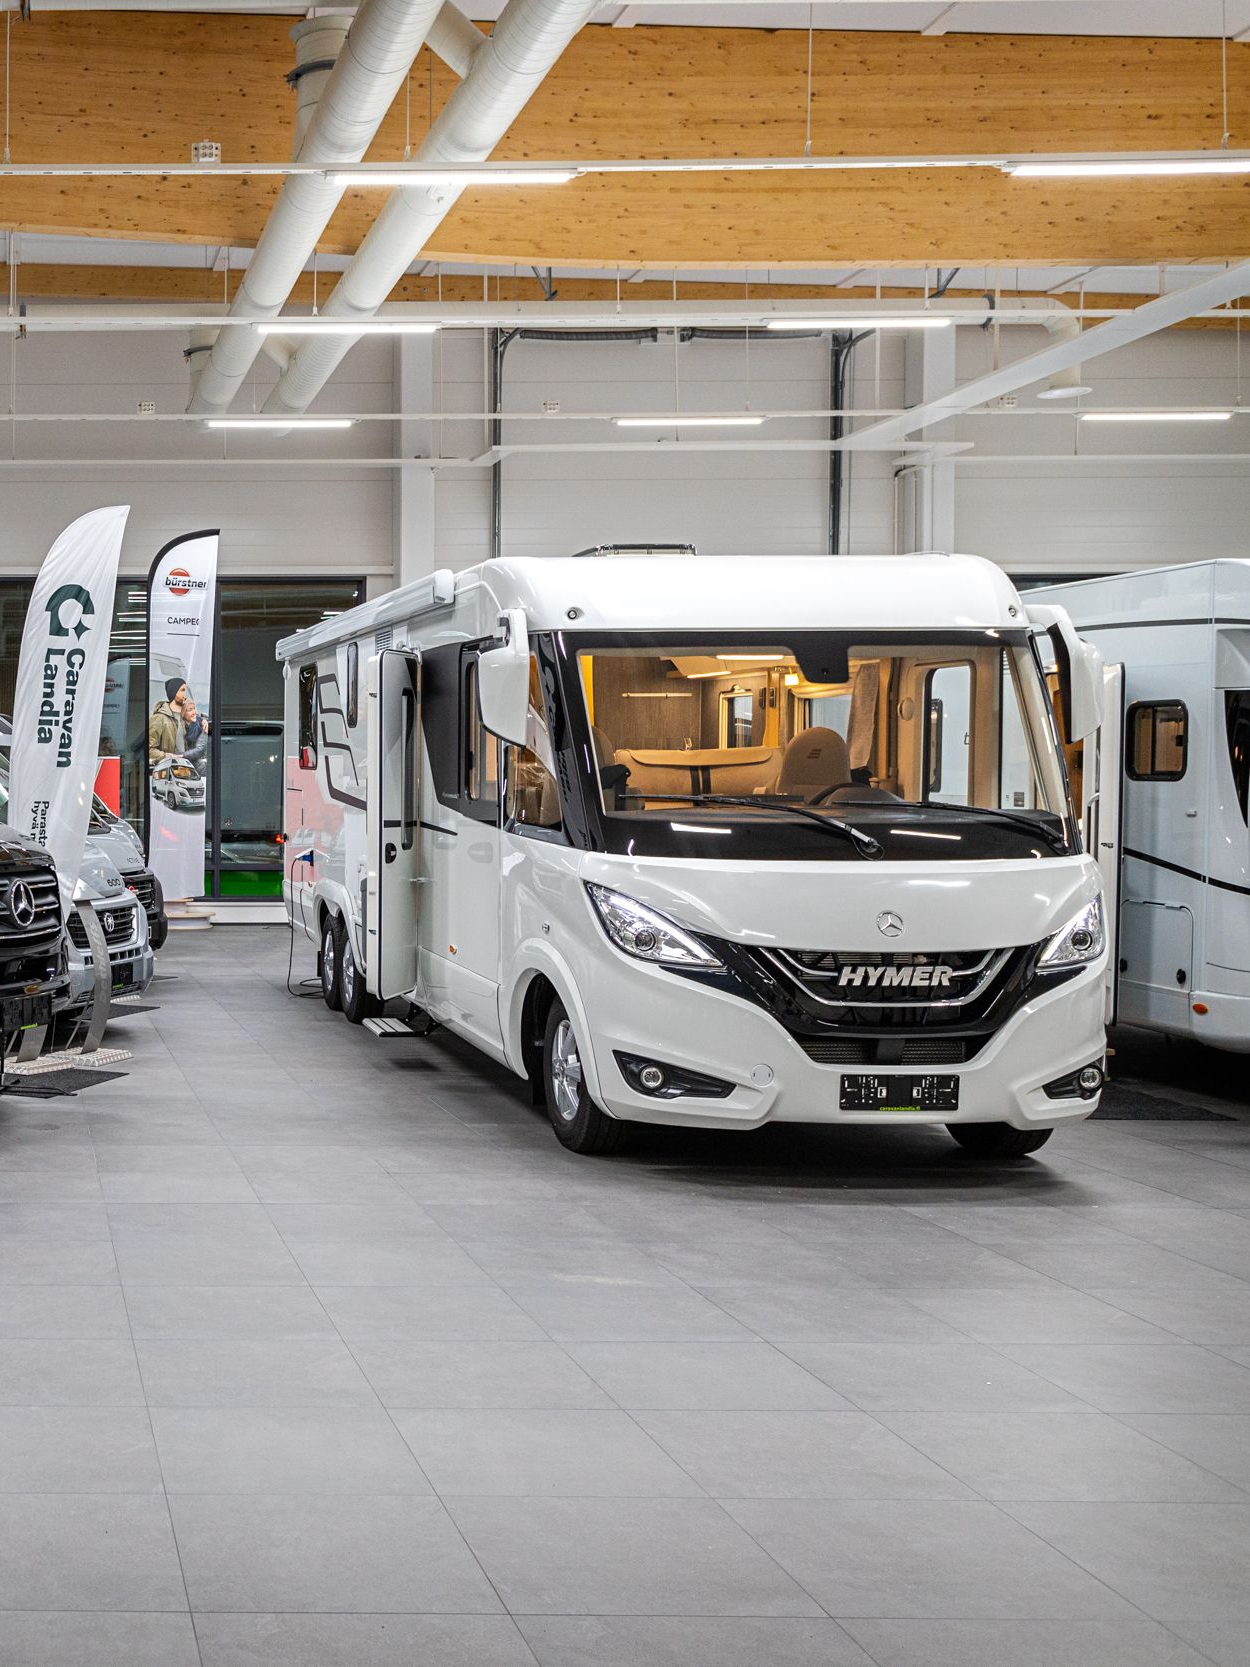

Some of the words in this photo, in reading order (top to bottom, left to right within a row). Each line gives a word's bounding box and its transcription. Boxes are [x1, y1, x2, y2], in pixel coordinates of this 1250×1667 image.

[165, 577, 206, 588] bürstner
[37, 648, 66, 744] Landia
[56, 648, 85, 768] Caravan
[31, 801, 41, 829] hyvä
[839, 965, 953, 986] HYMER
